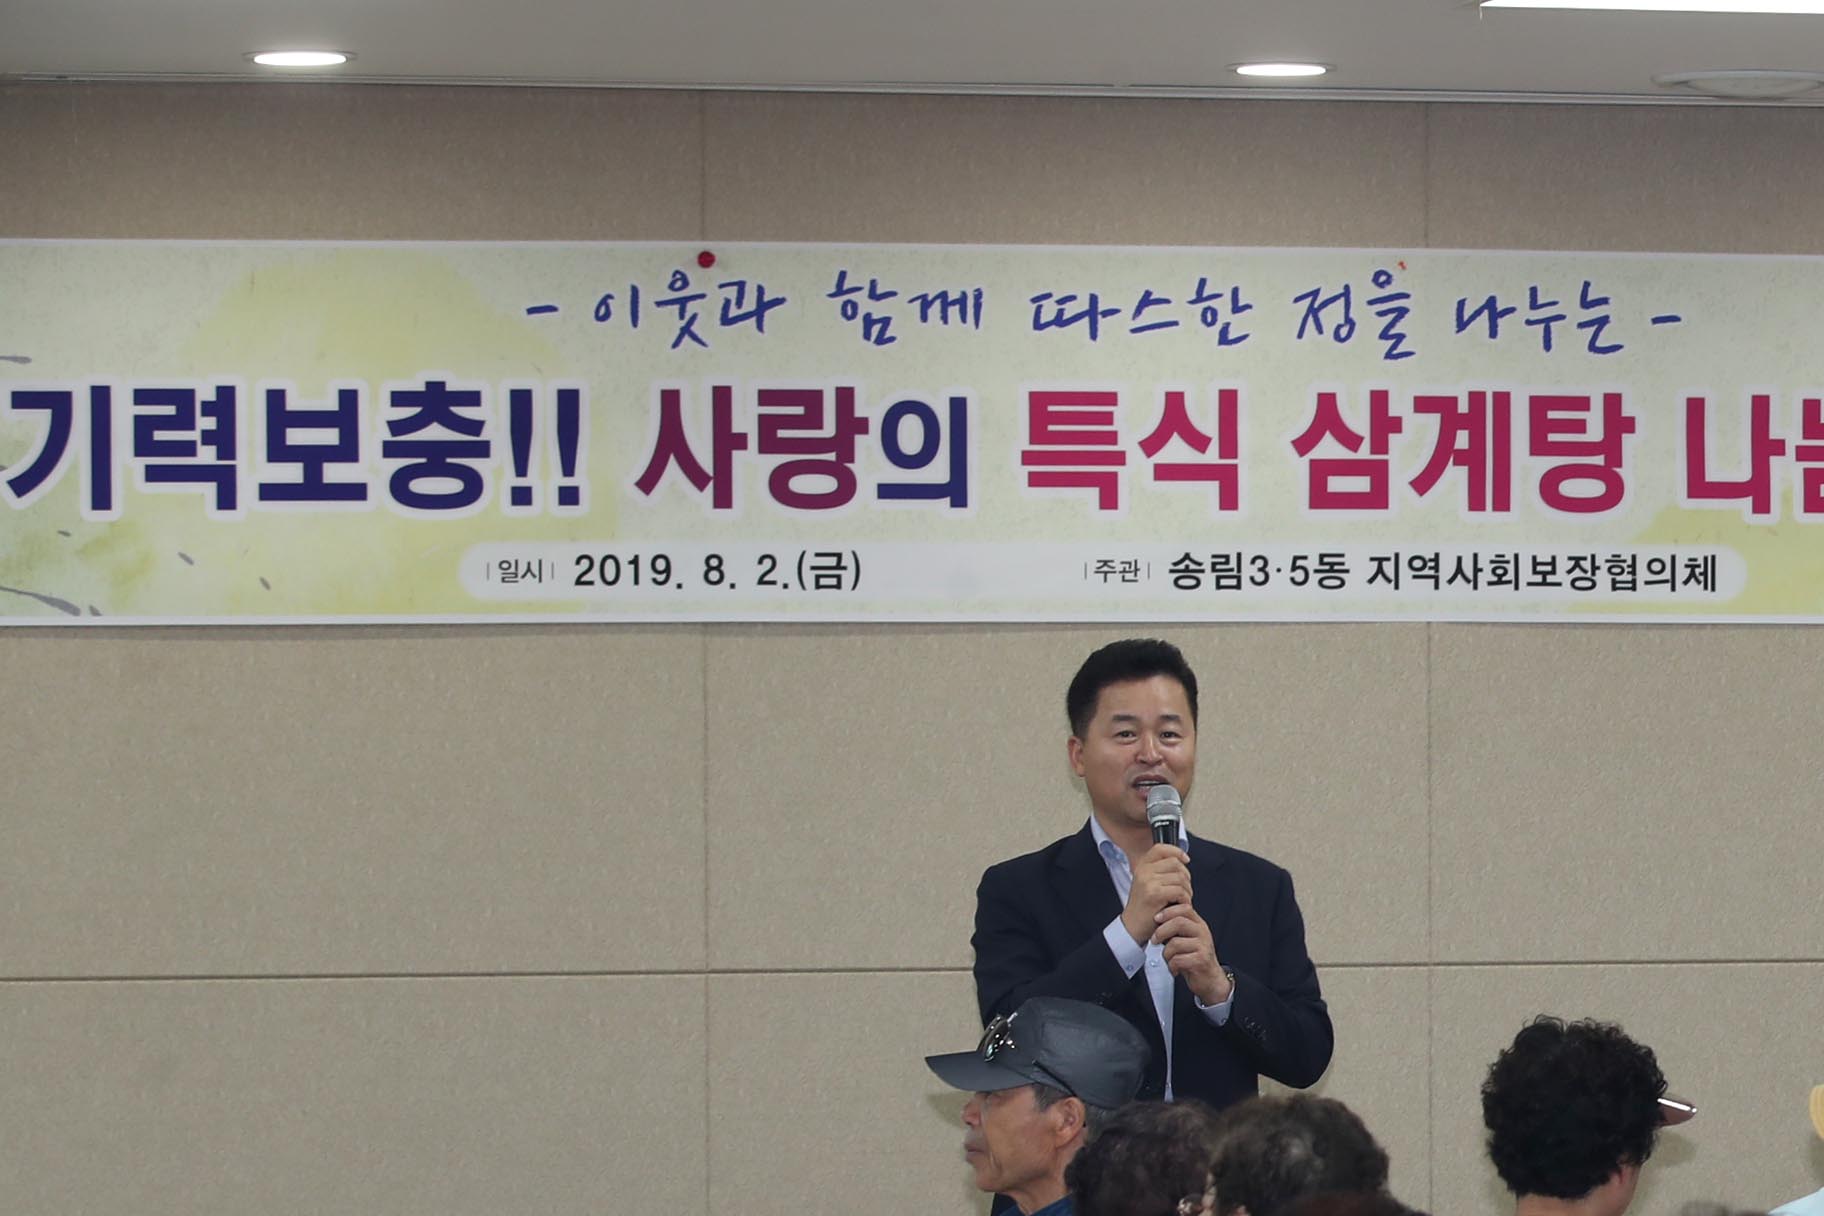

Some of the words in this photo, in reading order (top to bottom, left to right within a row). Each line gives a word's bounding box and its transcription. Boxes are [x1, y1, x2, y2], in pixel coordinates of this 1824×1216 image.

[594, 270, 787, 349] 이웃과
[825, 269, 984, 347] 함께
[1030, 277, 1254, 347] 따스한
[1292, 268, 1417, 361] 정을
[1455, 280, 1625, 355] 나누는
[5, 380, 581, 511] 기력보충!!
[634, 385, 969, 511] 사랑의
[1020, 388, 1239, 512] 특식
[1290, 389, 1637, 514] 삼계탕
[574, 553, 683, 590] 2019.
[703, 553, 736, 590] 8.
[1366, 551, 1718, 593] 지역사회보장협의체
